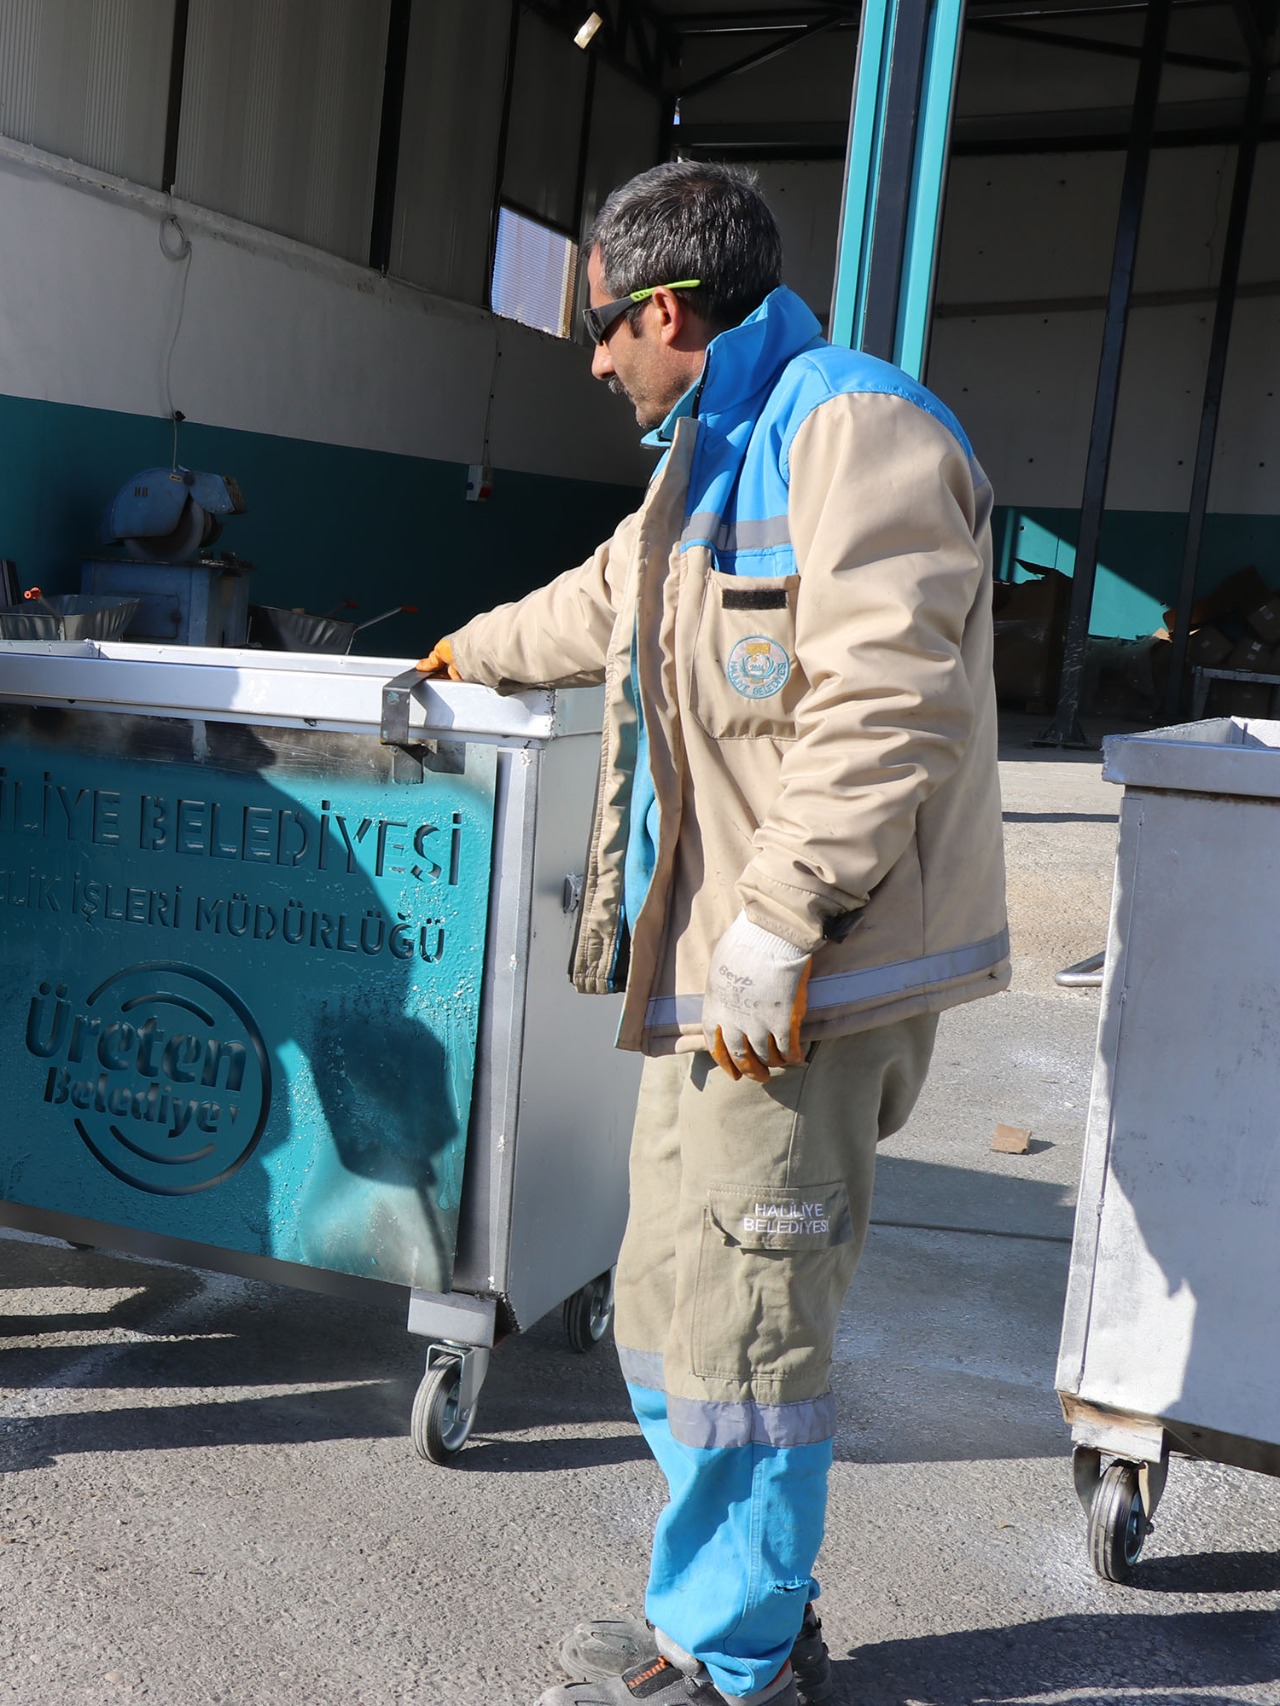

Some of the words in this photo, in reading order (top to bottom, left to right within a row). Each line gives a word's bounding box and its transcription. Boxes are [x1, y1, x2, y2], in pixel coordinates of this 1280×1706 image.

[139, 795, 464, 886] BELEDİYESİ
[71, 872, 181, 928] İŞLERİ
[195, 892, 446, 964] MÜDÜRLÜĞÜ
[25, 981, 247, 1092] Üreten
[742, 1216, 831, 1235] BELEDİYESİ
[754, 1202, 825, 1218] HALİLİYE
